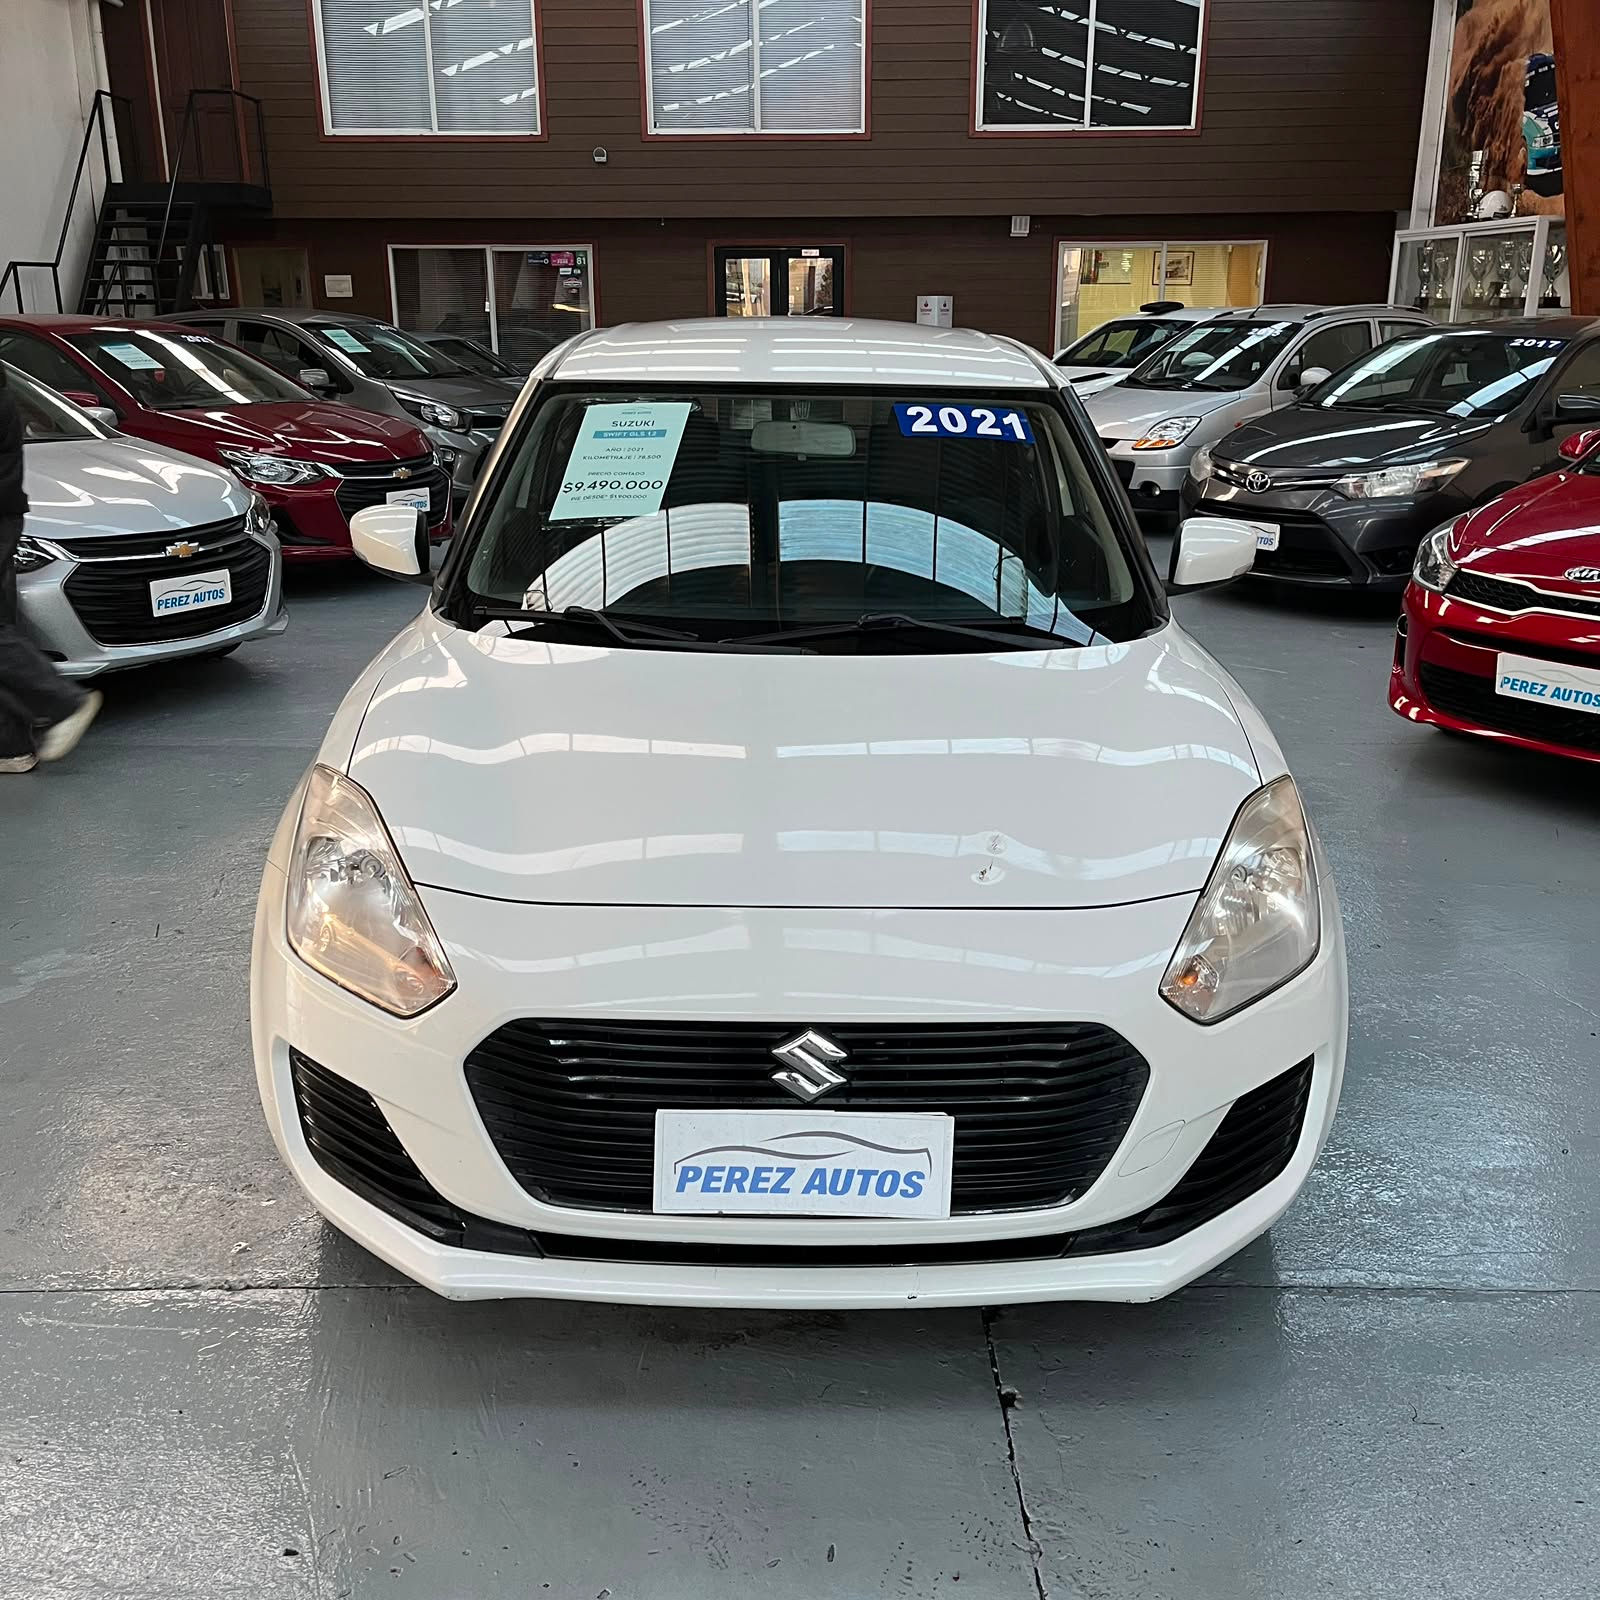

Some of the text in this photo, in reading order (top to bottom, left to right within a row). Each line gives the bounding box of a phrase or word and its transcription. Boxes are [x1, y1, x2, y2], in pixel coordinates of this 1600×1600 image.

[1509, 338, 1562, 348] 2017
[906, 405, 1026, 440] 2021
[562, 480, 663, 494] $9.490.000
[157, 588, 225, 610] PEREZ AUTOS
[1500, 676, 1548, 696] PEREZ
[675, 1165, 926, 1199] PEREZ AUTOS
